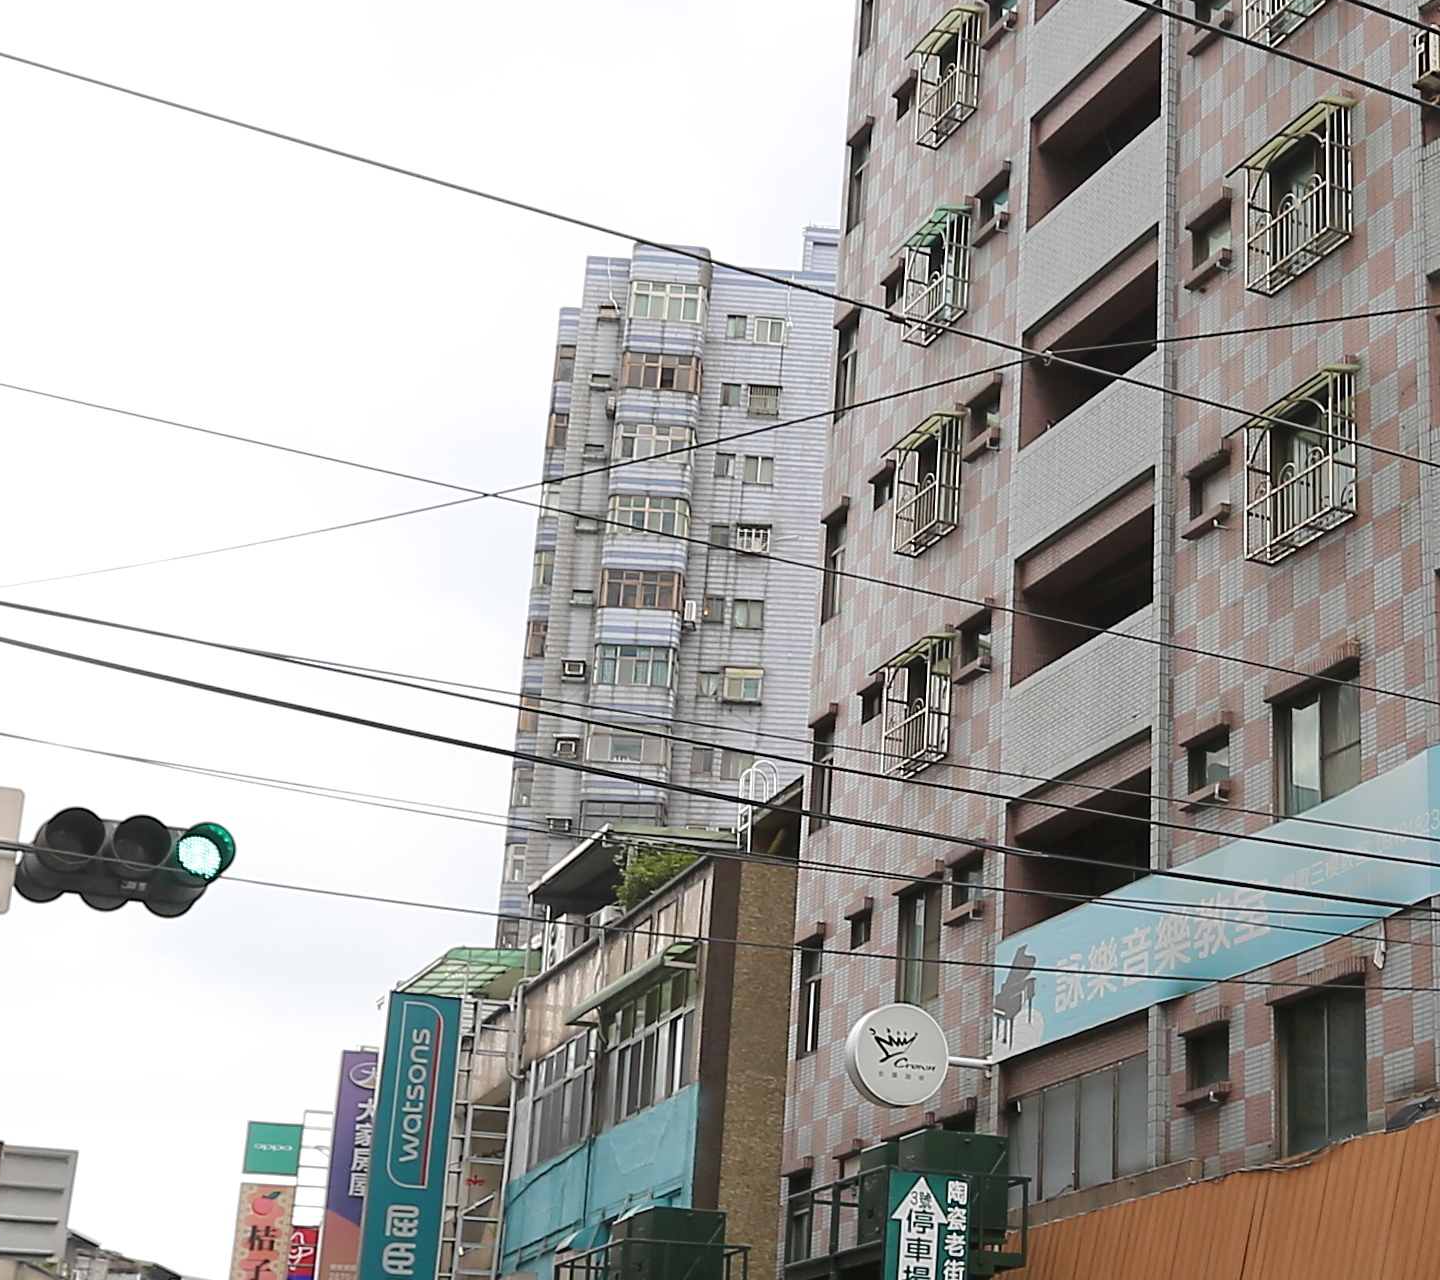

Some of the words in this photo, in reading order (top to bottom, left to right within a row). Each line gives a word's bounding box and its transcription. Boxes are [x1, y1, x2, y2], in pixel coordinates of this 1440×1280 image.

[1054, 877, 1272, 1015] 詠樂音樂教室
[398, 1026, 432, 1165] watsons
[253, 1142, 294, 1153] oppo
[909, 1189, 934, 1209] 3號
